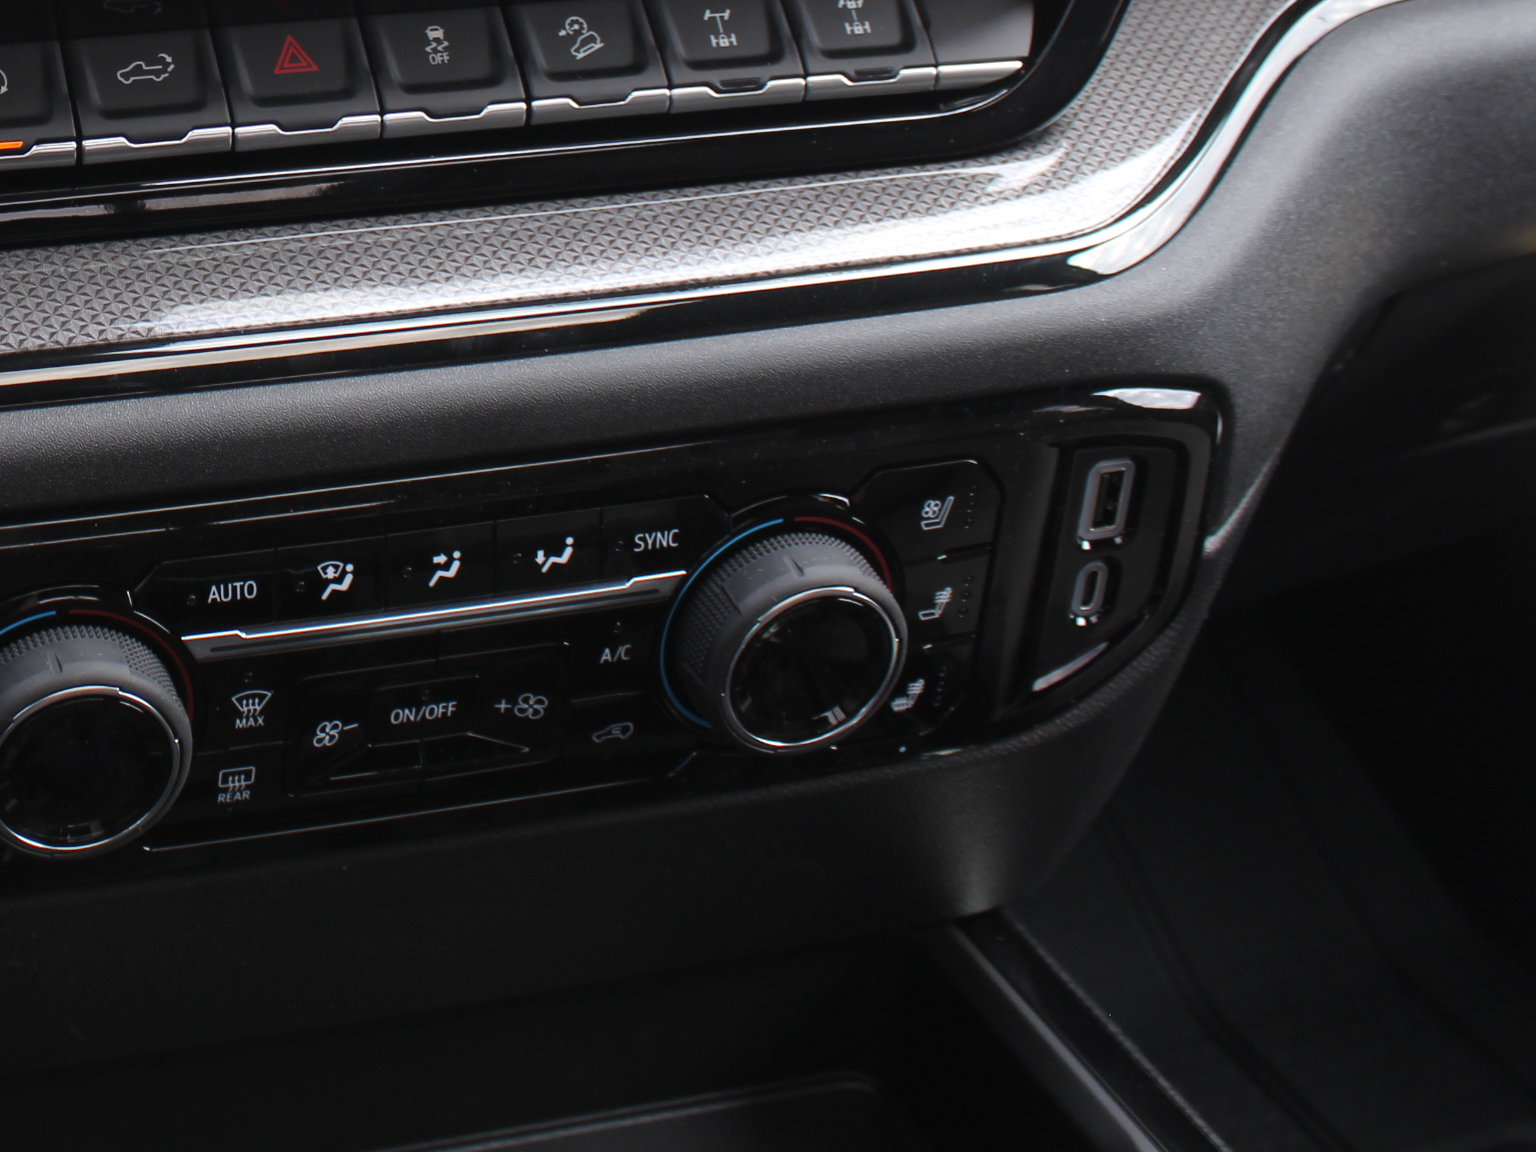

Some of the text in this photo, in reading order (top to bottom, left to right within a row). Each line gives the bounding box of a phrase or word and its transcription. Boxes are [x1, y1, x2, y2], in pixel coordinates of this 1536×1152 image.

[429, 52, 450, 66] OFF
[633, 529, 680, 552] SYNC
[207, 581, 258, 604] AUTO
[599, 645, 632, 664] A/C
[235, 716, 265, 729] MAX
[390, 701, 457, 725] ON/OFF
[217, 789, 251, 803] REAR
